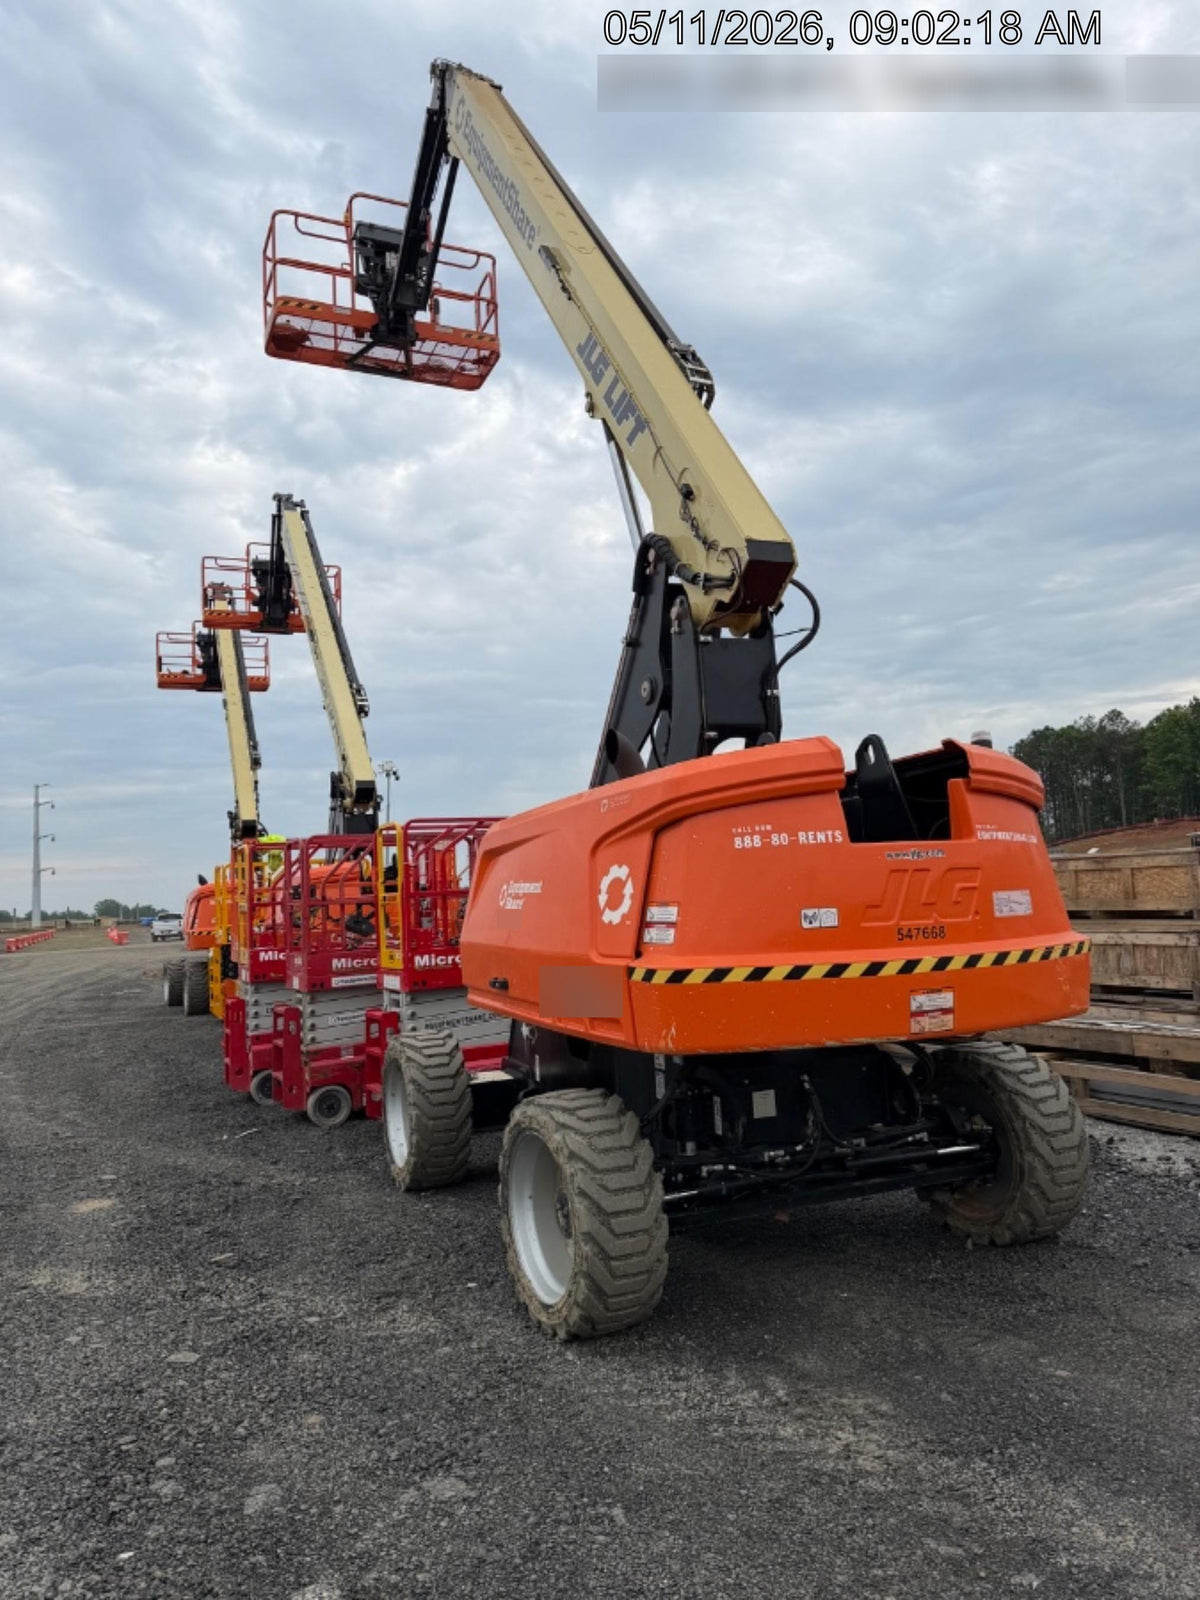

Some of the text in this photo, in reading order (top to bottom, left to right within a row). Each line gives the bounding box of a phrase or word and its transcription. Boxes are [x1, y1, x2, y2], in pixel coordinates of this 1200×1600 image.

[576, 331, 648, 447] JLG LIFT
[733, 830, 843, 849] 888-80-RENTS
[860, 867, 982, 926] JLG
[896, 925, 947, 941] 547668
